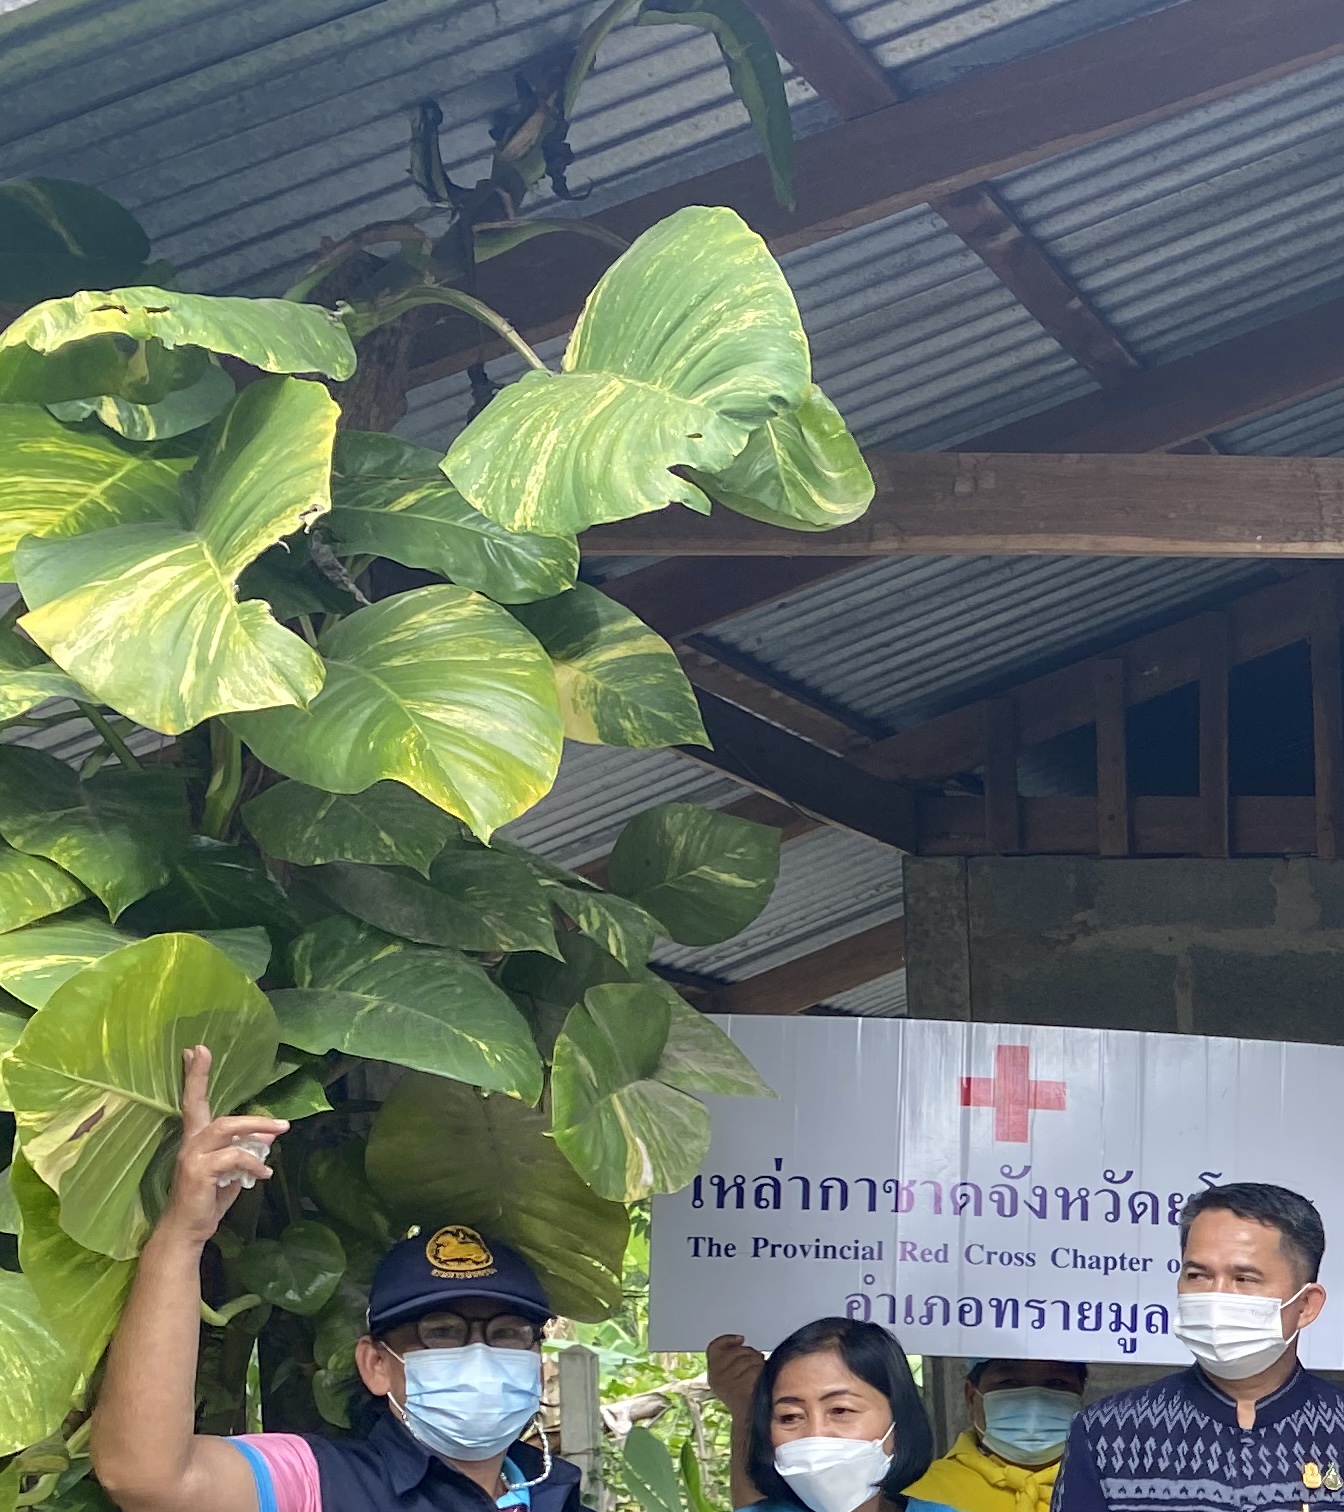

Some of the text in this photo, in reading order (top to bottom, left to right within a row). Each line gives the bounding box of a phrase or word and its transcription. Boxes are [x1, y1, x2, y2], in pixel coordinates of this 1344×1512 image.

[691, 1157, 1223, 1227] เหล่ากาชาดจังหวัดยโ
[687, 1236, 1182, 1276] The Provincial Red Cross Chapter o
[844, 1273, 1169, 1354] อำเภอทรายมูล
